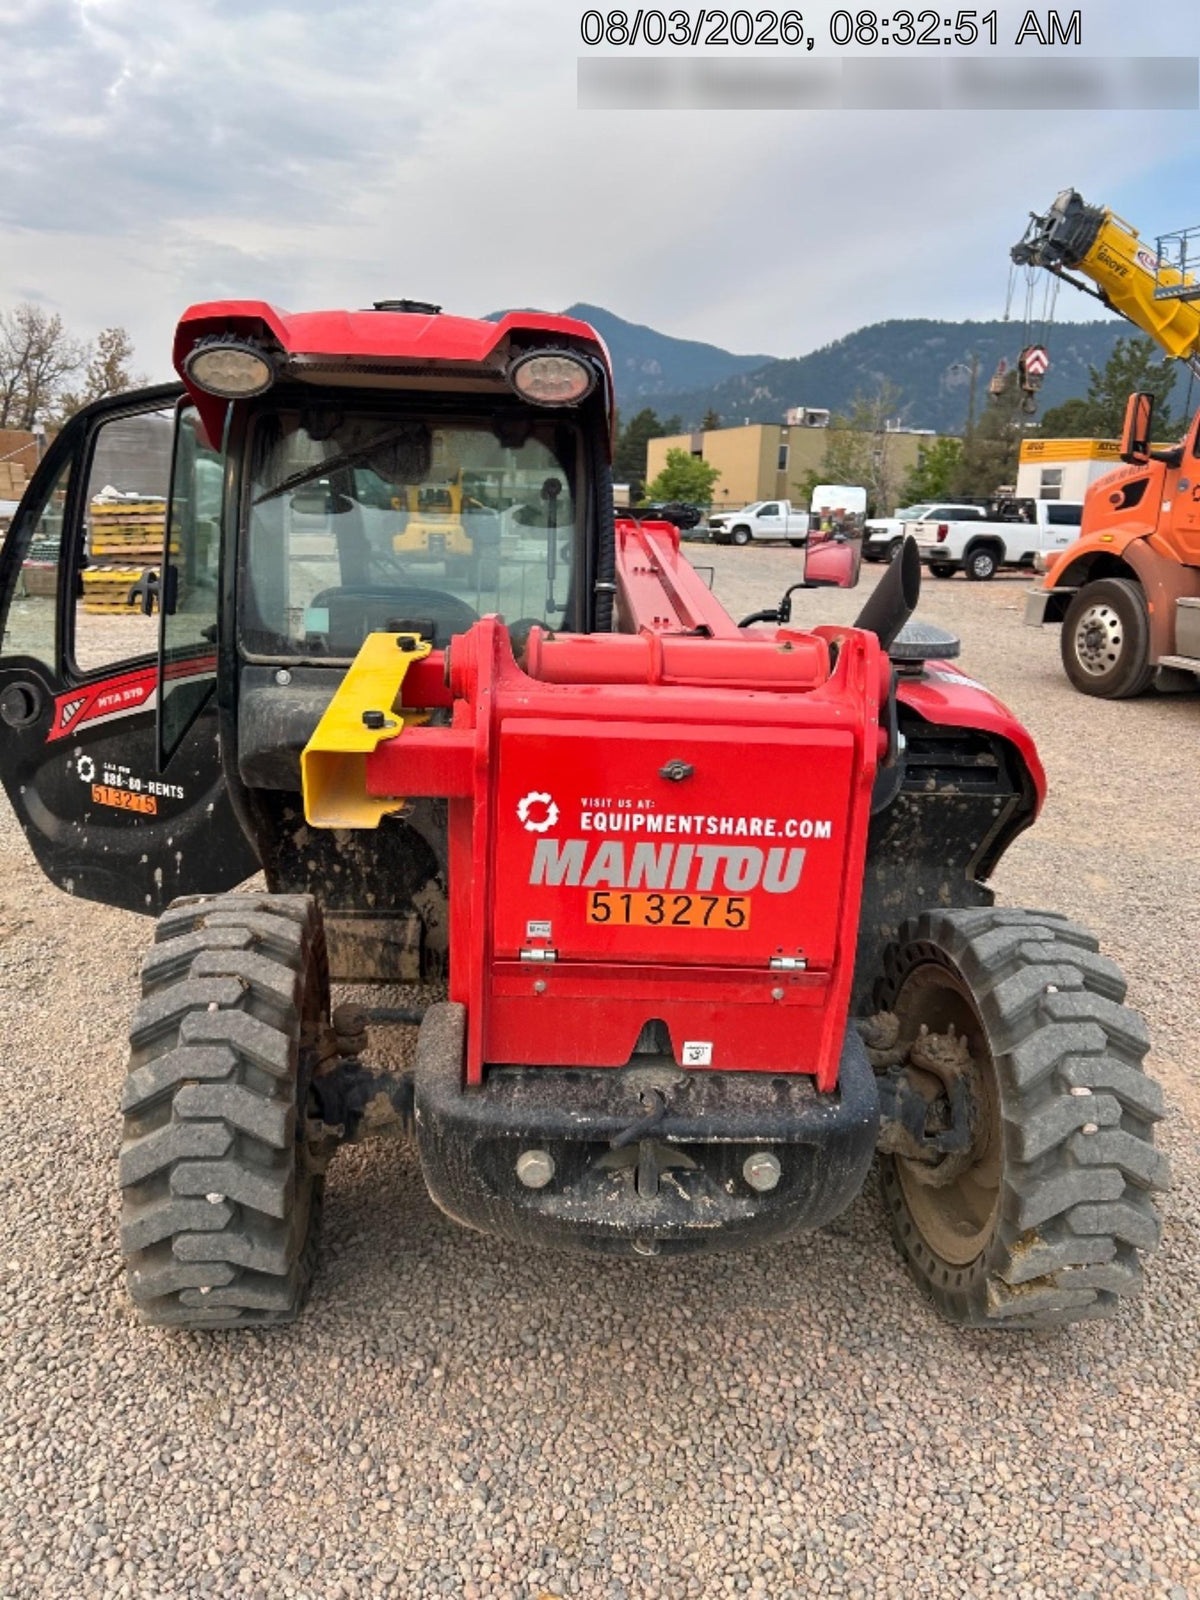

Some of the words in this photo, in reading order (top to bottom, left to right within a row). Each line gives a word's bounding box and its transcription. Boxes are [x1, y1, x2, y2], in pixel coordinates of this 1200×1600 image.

[581, 798, 612, 808] VISIT
[618, 799, 632, 808] US
[637, 800, 655, 809] AT:
[580, 812, 832, 838] EQUIPMENTSHARE.COM
[529, 839, 806, 893] MANITOU
[591, 892, 746, 928] 513275
